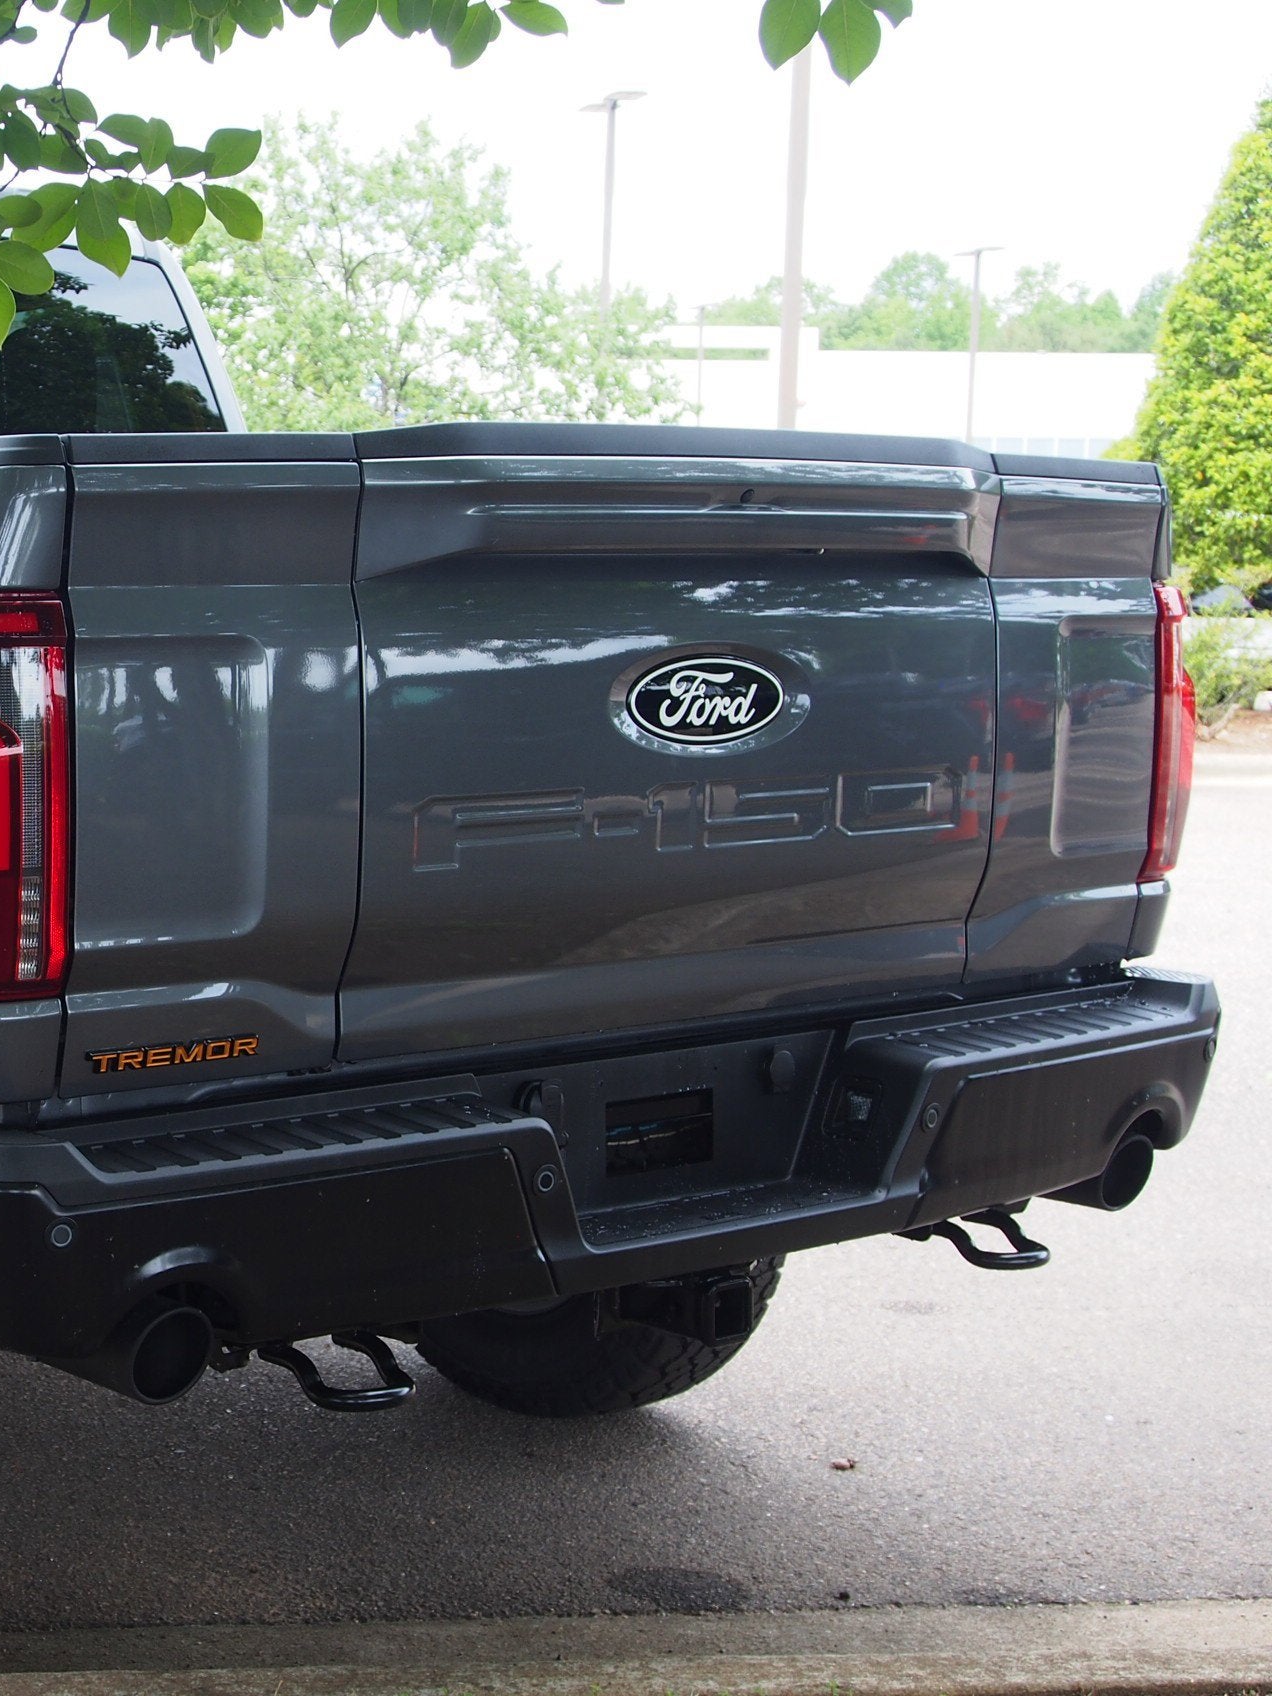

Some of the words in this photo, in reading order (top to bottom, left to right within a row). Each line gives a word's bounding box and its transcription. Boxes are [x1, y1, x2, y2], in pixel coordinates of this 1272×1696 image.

[658, 669, 759, 728] Ford
[412, 766, 964, 872] F-150
[88, 1034, 261, 1073] TREMOR
